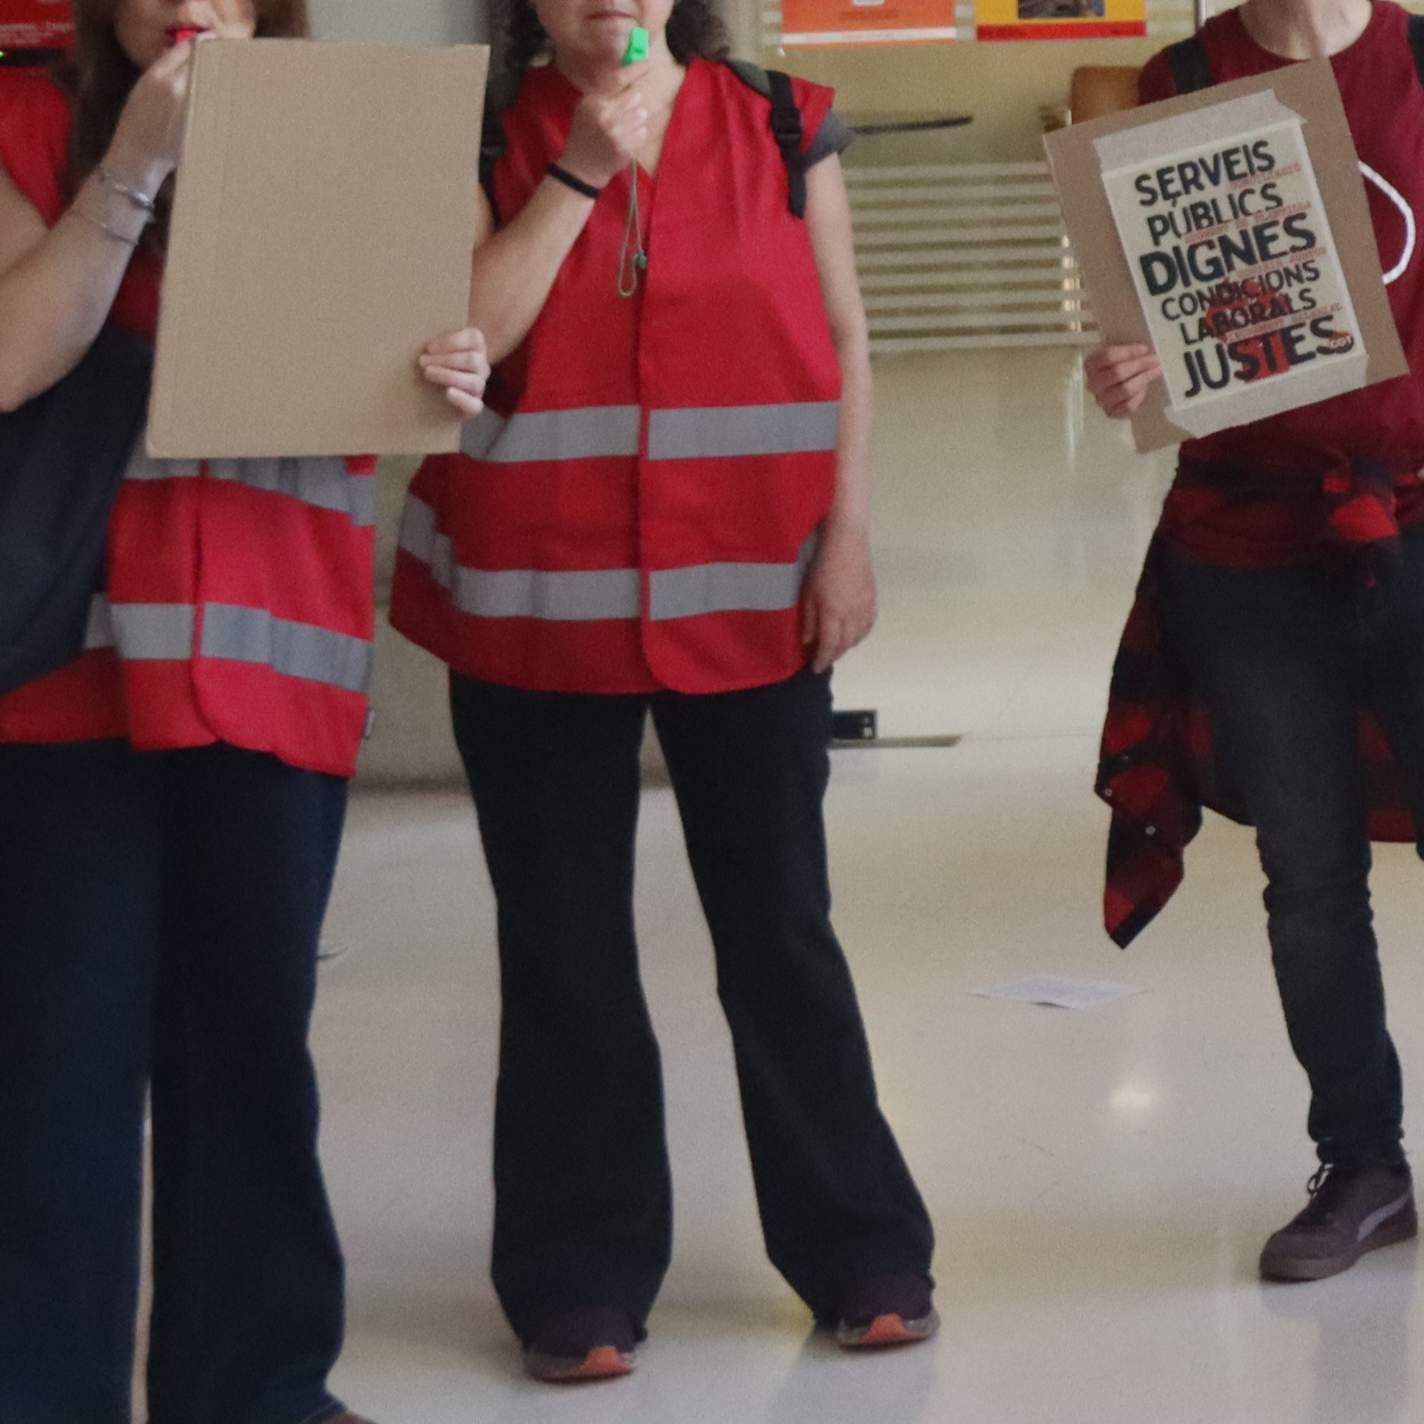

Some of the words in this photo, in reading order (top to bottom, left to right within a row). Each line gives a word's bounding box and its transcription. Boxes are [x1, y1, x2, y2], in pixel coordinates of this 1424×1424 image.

[1134, 140, 1275, 207] SERVEIS
[1139, 212, 1317, 297] DIGNES
[1161, 259, 1320, 321] CONDICIONS
[1180, 288, 1317, 346] LABORALS
[1184, 314, 1354, 398] JUSTES
